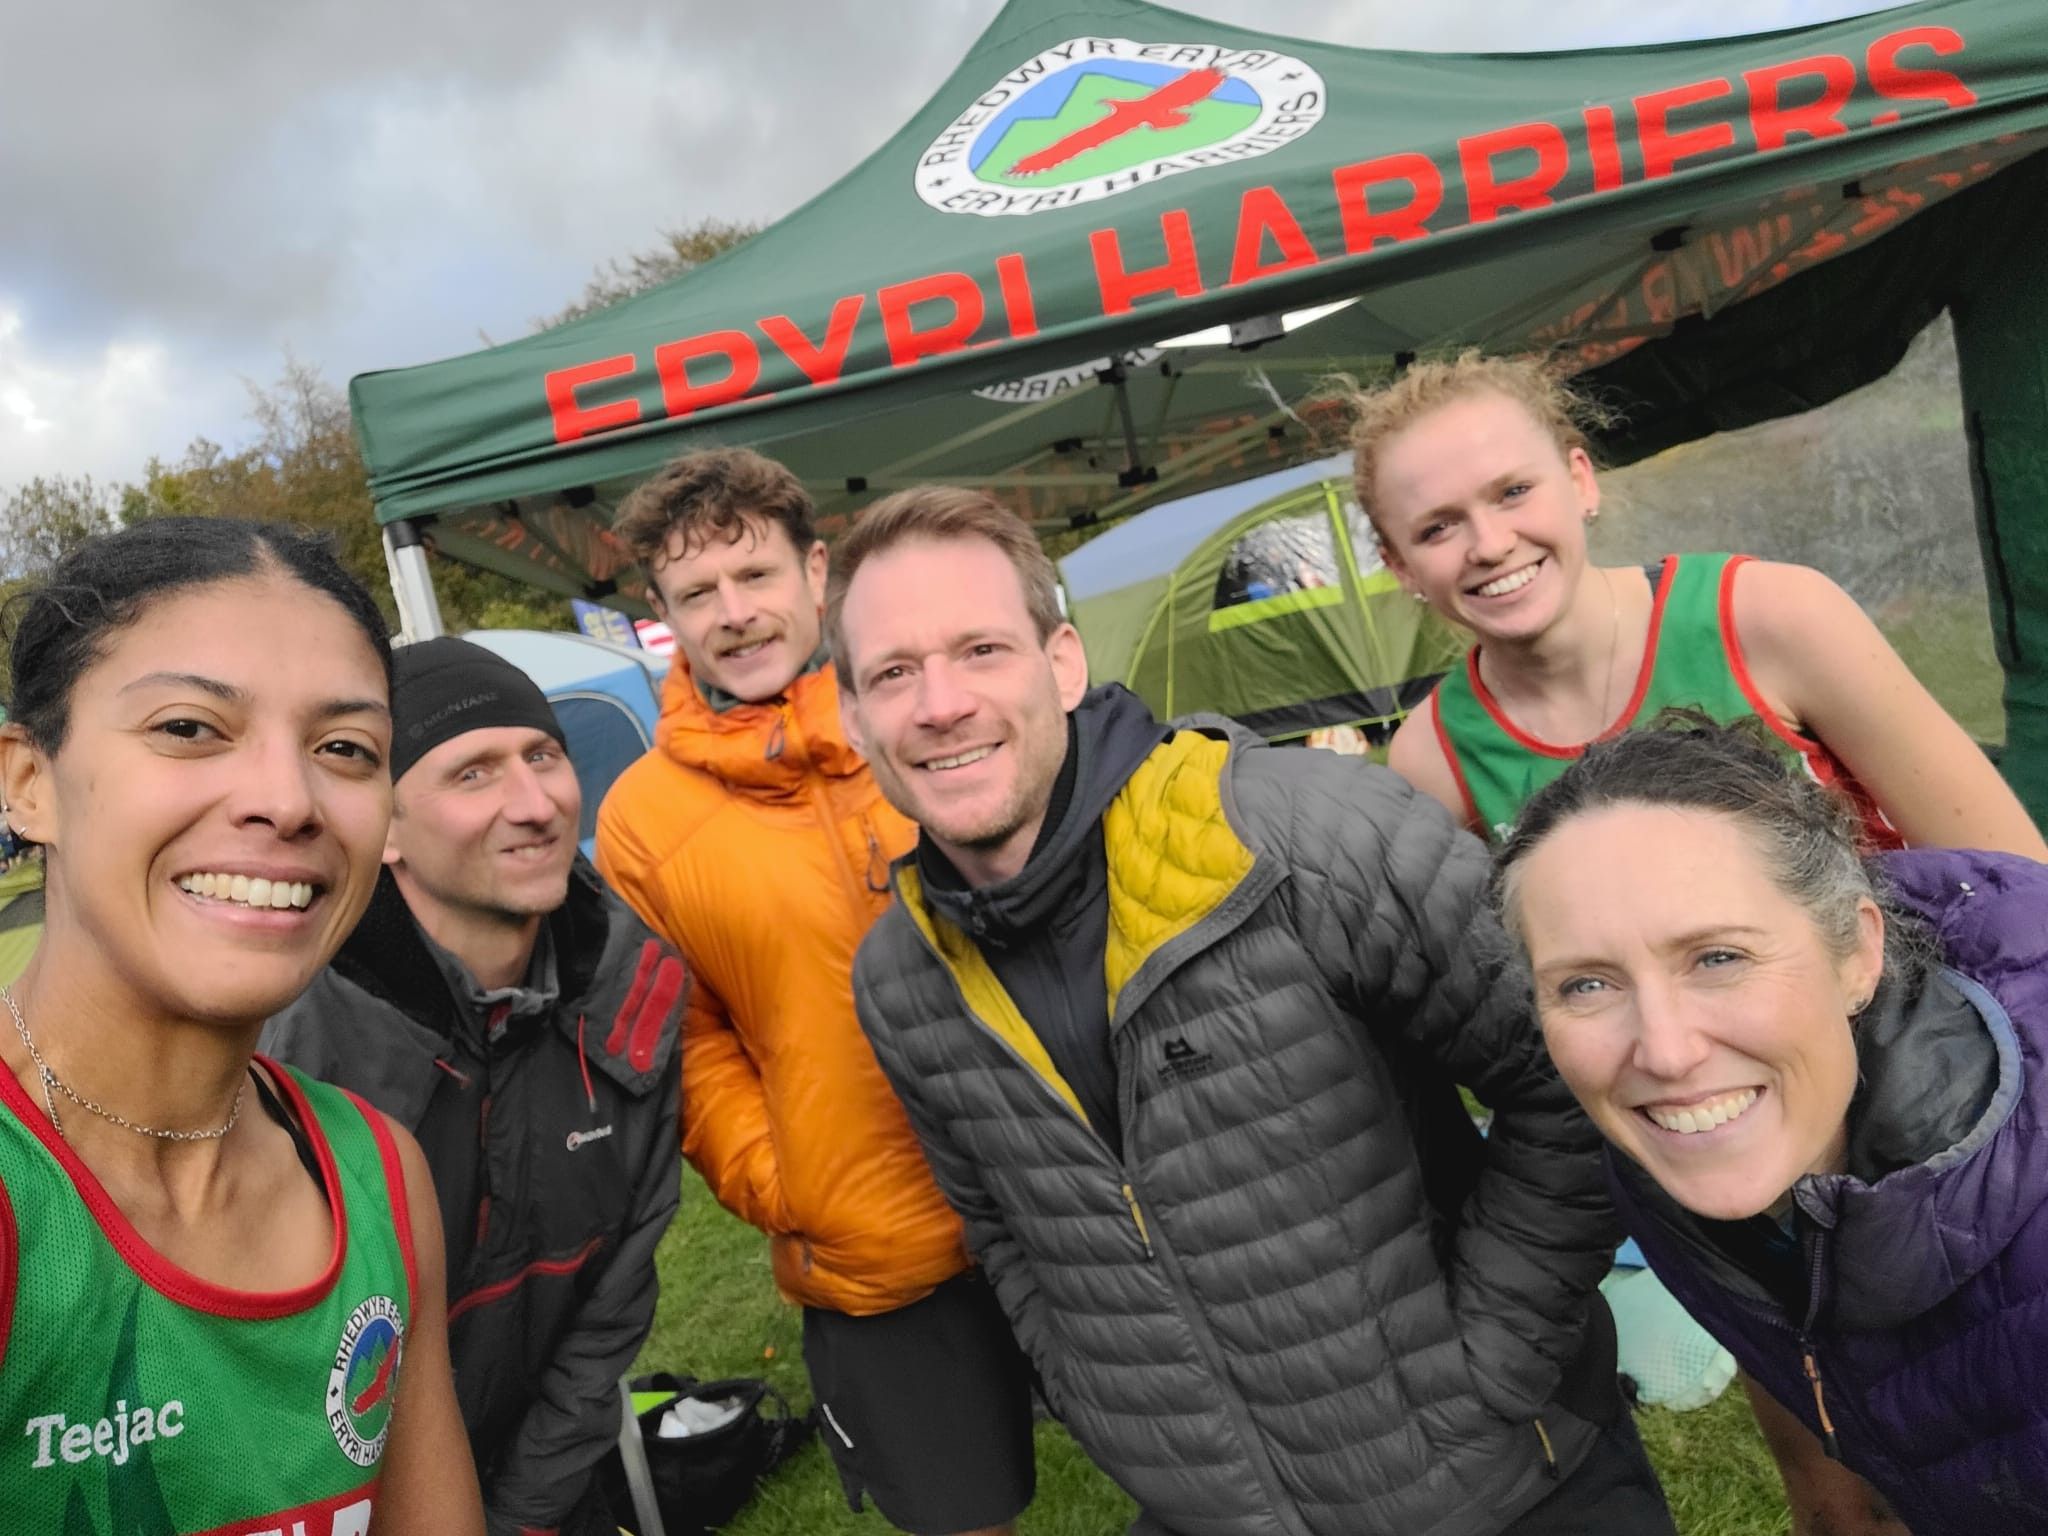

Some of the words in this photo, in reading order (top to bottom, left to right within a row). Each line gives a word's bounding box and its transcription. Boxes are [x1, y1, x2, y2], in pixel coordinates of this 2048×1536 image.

[922, 38, 1117, 168] RHEDWYR
[1136, 43, 1278, 73] ERYRI
[940, 187, 1084, 211] ERYRI
[1103, 90, 1320, 193] HARRIERS
[545, 253, 1040, 444] ERYRI
[1089, 25, 1978, 316] HARRIERS
[334, 1296, 386, 1372] RHEDWYR
[25, 1400, 185, 1469] Teejac
[329, 1409, 362, 1464] ERYRI
